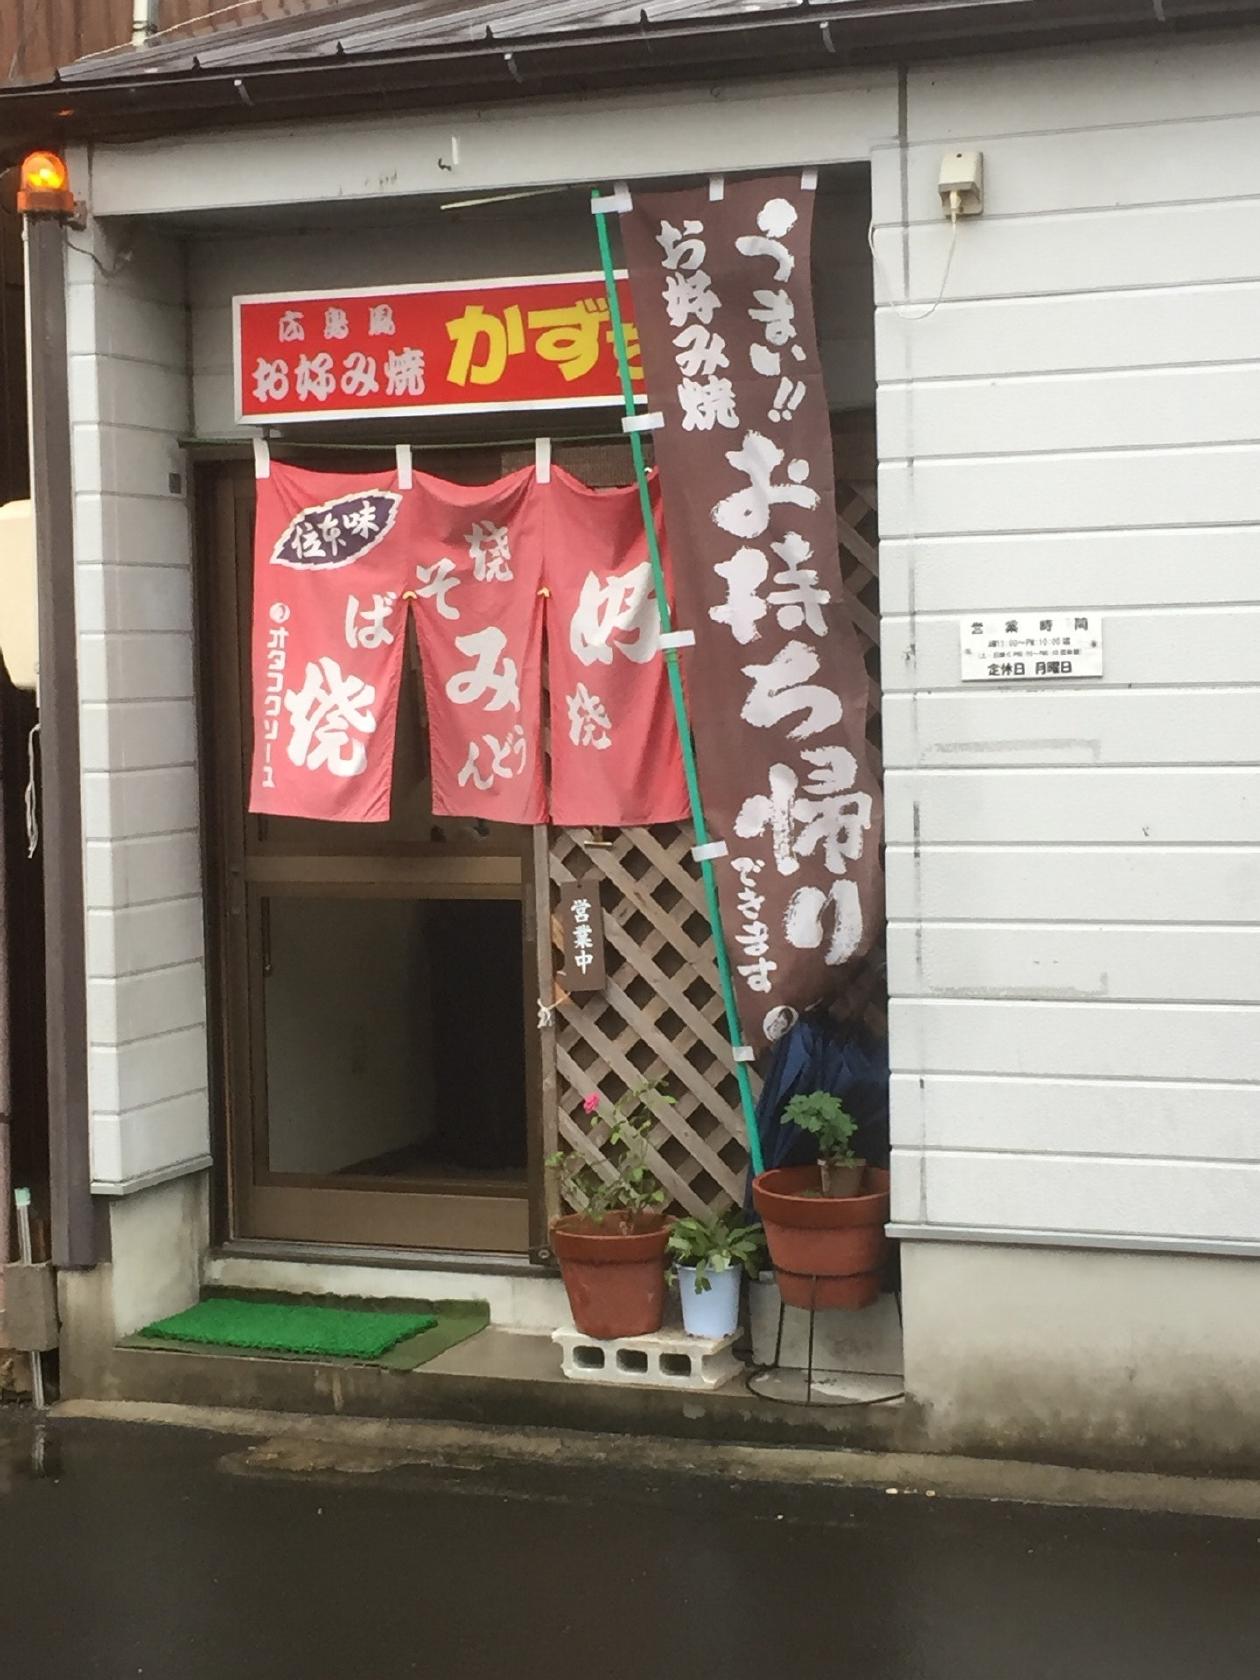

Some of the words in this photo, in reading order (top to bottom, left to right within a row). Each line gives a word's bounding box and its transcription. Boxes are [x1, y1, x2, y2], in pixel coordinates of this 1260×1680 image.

[279, 304, 396, 342] 広島風
[656, 220, 739, 431] お好み焼
[252, 347, 425, 402] お好み焼
[971, 617, 1088, 635] 営業時間
[709, 430, 873, 966] お持ち帰り
[987, 662, 1026, 676] 定休日
[1035, 661, 1073, 674] 月曜日
[570, 898, 593, 975] 営業中
[731, 857, 777, 993] できます
